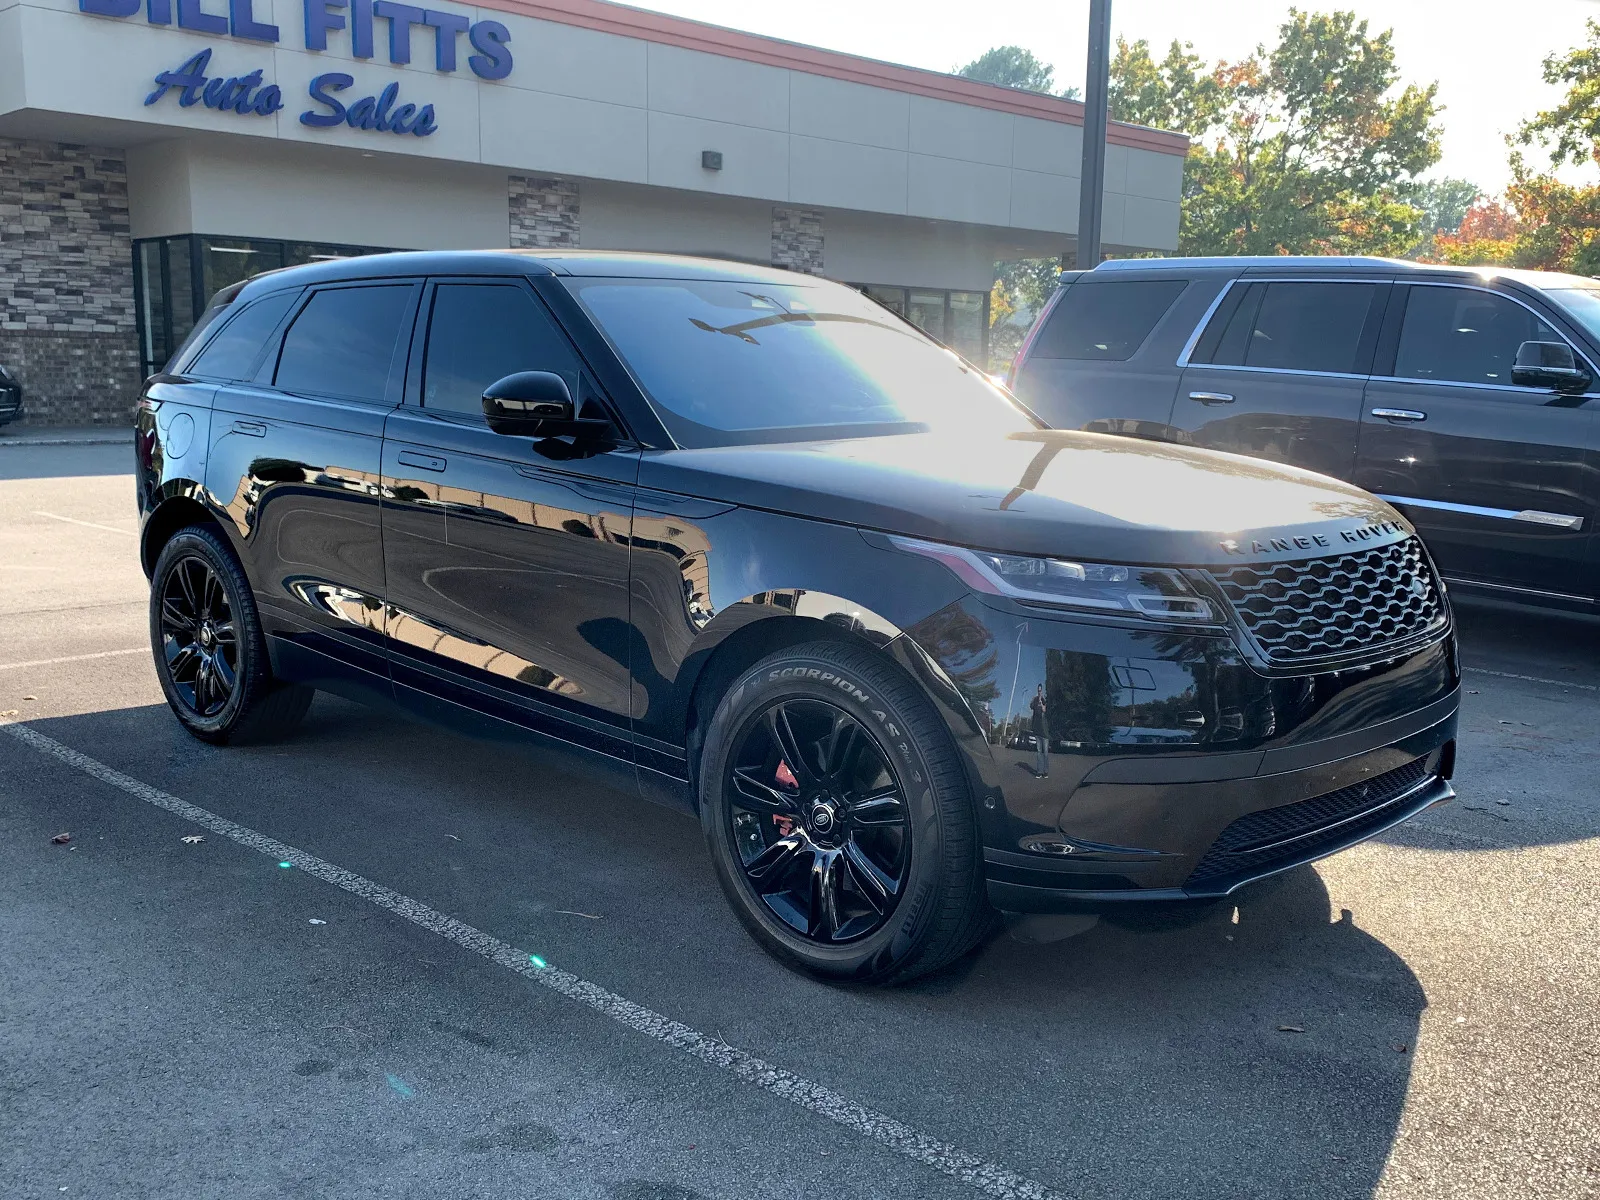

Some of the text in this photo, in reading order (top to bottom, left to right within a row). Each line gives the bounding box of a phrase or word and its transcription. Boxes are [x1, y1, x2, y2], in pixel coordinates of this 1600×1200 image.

[79, 0, 513, 80] LL FITTS
[144, 47, 438, 137] Auto Sales
[1219, 520, 1404, 556] RANGE ROVER
[768, 667, 870, 703] SCORPION
[871, 709, 900, 737] AS
